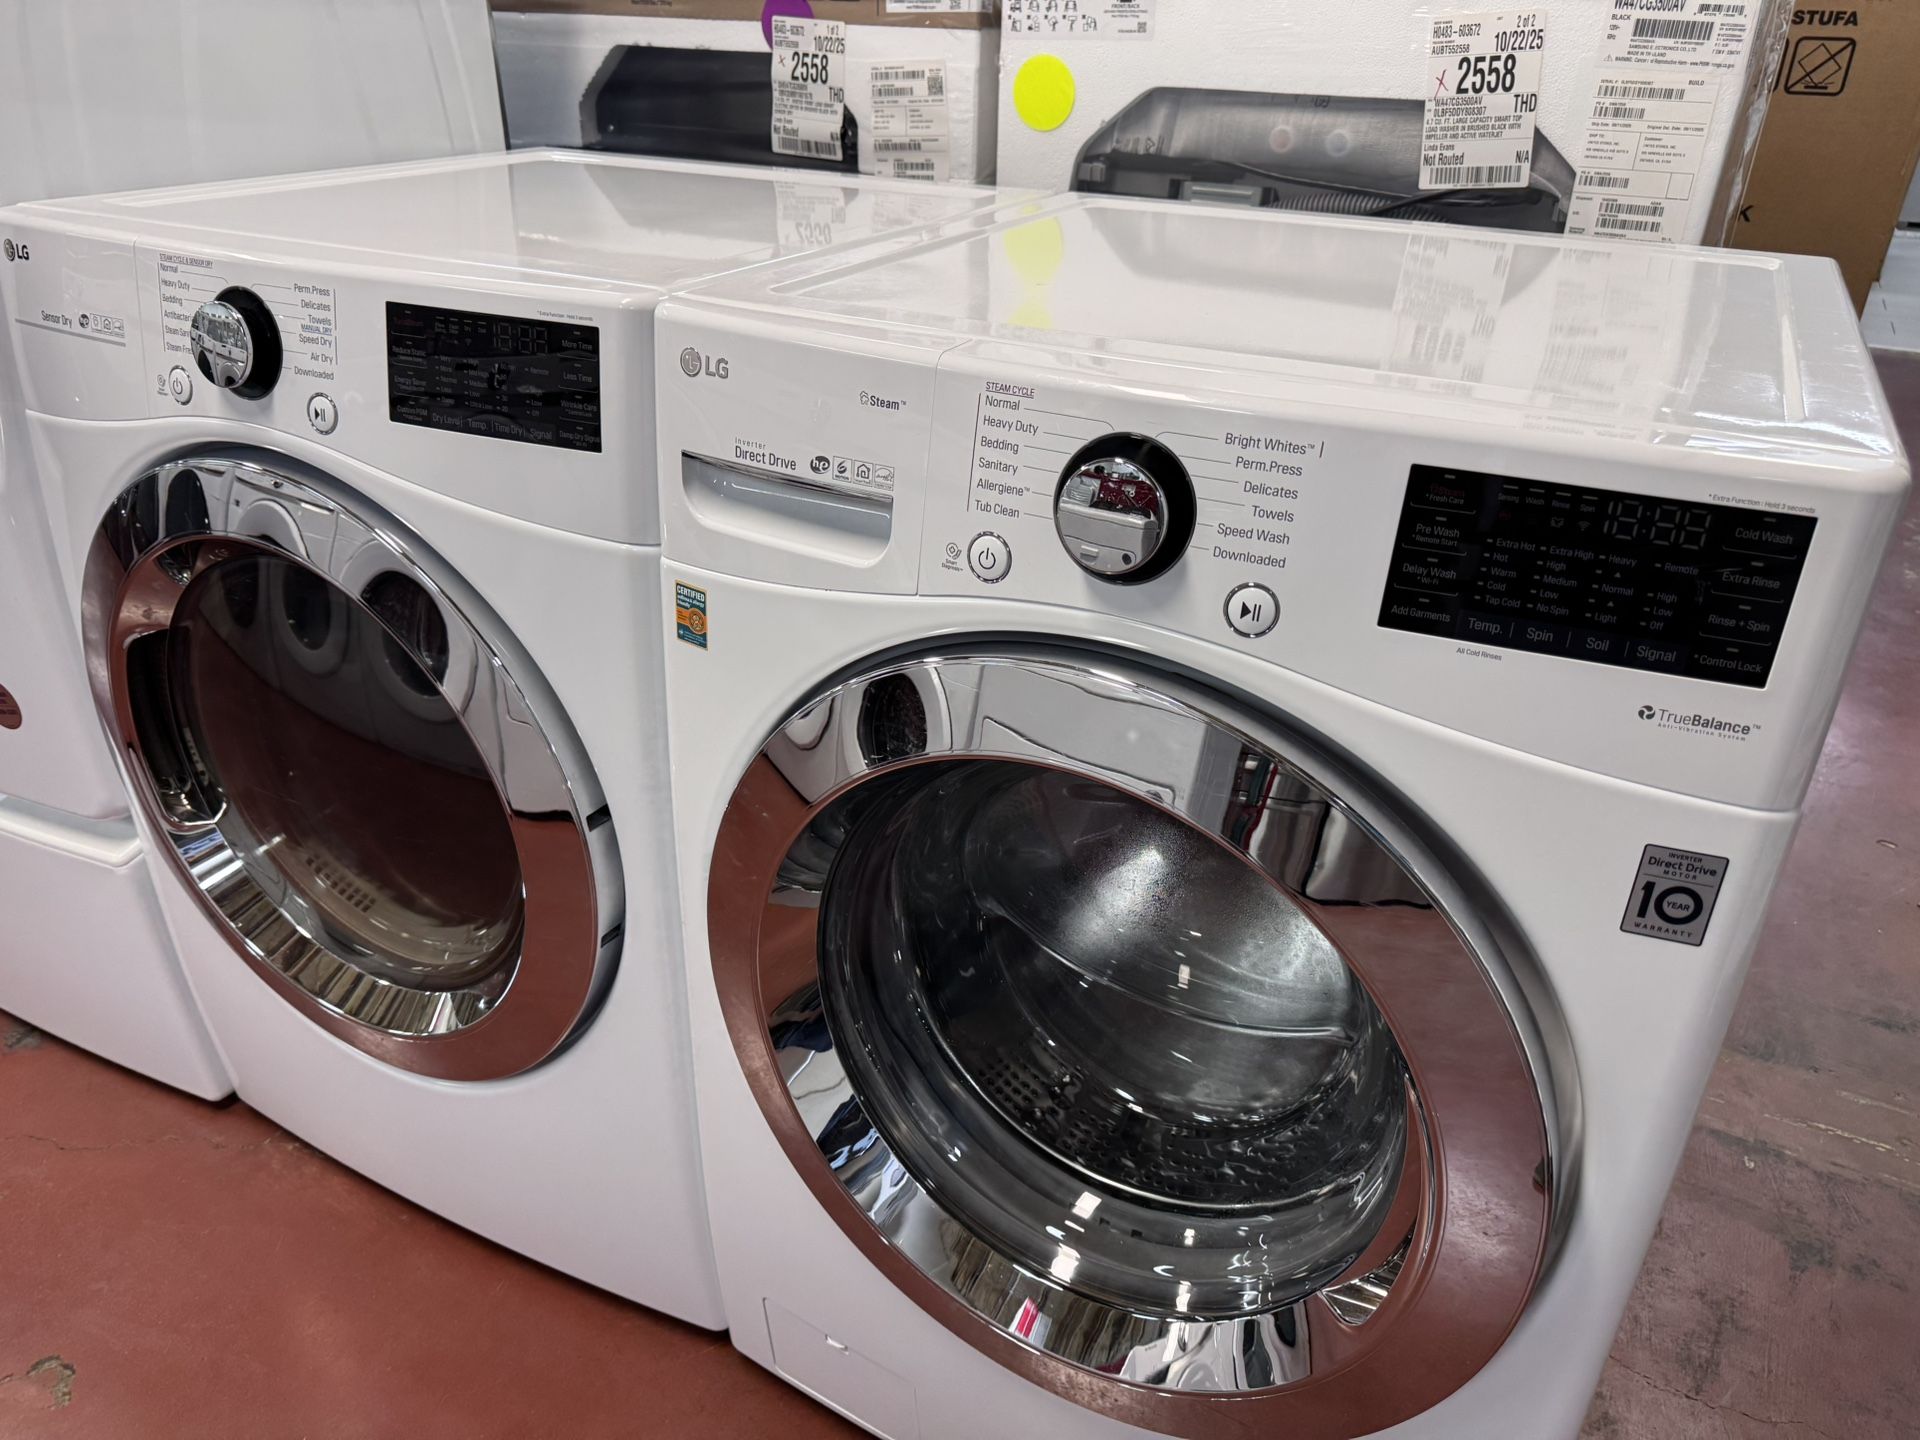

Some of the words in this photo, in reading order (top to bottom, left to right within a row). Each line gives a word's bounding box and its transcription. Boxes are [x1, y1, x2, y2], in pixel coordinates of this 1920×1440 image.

[1791, 10, 1858, 26] STUFA
[814, 36, 845, 54] 10/22/25
[1495, 28, 1544, 52] 10/22/25
[792, 52, 828, 84] 2558
[1456, 54, 1516, 94] 2558
[829, 87, 844, 104] THD
[1514, 94, 1537, 112] THD
[1423, 153, 1436, 166] Not
[1438, 152, 1464, 166] Routed
[1516, 150, 1529, 163] N/A
[16, 244, 29, 260] LG
[160, 263, 178, 273] Normal
[161, 278, 177, 289] Heavy
[178, 280, 190, 292] Duty
[294, 284, 330, 296] Perm.Press
[162, 294, 183, 306] Bedding
[301, 299, 331, 311] Delicates
[41, 310, 60, 324] Sensor
[61, 314, 72, 328] Dry
[308, 314, 332, 326] Towels
[166, 325, 180, 335] Steam
[299, 334, 319, 344] Speed
[320, 338, 332, 348] Dry
[562, 340, 577, 348] More
[578, 342, 593, 350] Time
[311, 352, 320, 361] Air
[322, 354, 333, 365] Dry
[294, 366, 334, 380] Downloaded
[705, 355, 729, 379] LG
[563, 372, 578, 380] Less
[578, 374, 593, 382] Time
[986, 381, 1011, 393] STEAM
[1012, 386, 1035, 397] CYCLE
[985, 395, 1020, 411] Normal
[432, 413, 444, 423] Dry
[444, 414, 460, 425] Level
[467, 418, 486, 430] Temp.
[983, 415, 1014, 431] Heavy
[1015, 420, 1039, 436] Duty
[495, 421, 511, 432] Time
[512, 424, 522, 436] Dry
[530, 428, 552, 440] Signal
[735, 437, 766, 450] Inverter
[980, 436, 1019, 454] Bedding
[1225, 432, 1261, 449] Bright
[735, 446, 766, 464] Direct
[768, 453, 797, 470] Drive
[979, 457, 1018, 476] Sanitary
[1235, 456, 1303, 476] Perm.Press
[1244, 480, 1298, 500] Delicates
[975, 500, 992, 513] Tub
[993, 502, 1020, 518] Clean
[1712, 494, 1730, 502] Extra
[1732, 496, 1760, 505] Function
[1787, 504, 1816, 514] seconds
[1252, 505, 1294, 522] Towels
[1217, 523, 1254, 540] Speed
[1257, 529, 1290, 545] Wash
[1416, 523, 1432, 534] Pre
[1434, 525, 1460, 538] Wash
[1735, 528, 1759, 540] Cold
[1761, 531, 1794, 544] Wash
[1496, 538, 1519, 550] Extra
[1520, 541, 1536, 552] Hot
[1213, 546, 1286, 568] Downloaded
[1493, 553, 1509, 562] Hot
[1550, 546, 1573, 557] Extra
[1574, 549, 1594, 561] High
[1546, 560, 1567, 571] High
[1609, 555, 1637, 568] Heavy
[1402, 562, 1429, 576] Delay
[1430, 566, 1456, 580] Wash
[1490, 567, 1517, 578] Warm
[1664, 562, 1699, 576] Remote
[1486, 580, 1506, 591] Cold
[1542, 574, 1577, 587] Medium
[1722, 572, 1750, 585] Extra
[1752, 575, 1781, 589] Rinse
[677, 585, 705, 602] CERTIFIED
[1539, 589, 1559, 600] Low
[1602, 584, 1634, 596] Normal
[1485, 595, 1500, 607] Tap
[1501, 596, 1521, 608] Cold
[1657, 592, 1678, 603] High
[1391, 604, 1409, 615] Add
[1410, 608, 1451, 623] Garments
[1536, 604, 1549, 613] No
[1550, 605, 1569, 616] Spin
[1653, 607, 1673, 618] Low
[1594, 612, 1617, 624] Light
[1708, 614, 1736, 628] Rinse
[1747, 621, 1770, 632] Spin
[1468, 617, 1503, 634] Temp.
[1650, 621, 1664, 631] Off
[1526, 627, 1554, 642] Spin
[1586, 637, 1609, 651] Soil
[1466, 648, 1480, 656] Cold
[1481, 651, 1502, 660] Rinses
[1636, 646, 1677, 662] Signal
[1700, 654, 1737, 670] Control
[1738, 660, 1762, 673] Lock
[1658, 723, 1714, 736] Anti-Vibration
[1668, 852, 1702, 863] INVERTER
[1648, 856, 1683, 870] Direct
[1686, 864, 1717, 877] Drive
[1663, 870, 1697, 880] MOTOR
[1637, 880, 1703, 925] 10
[1666, 900, 1690, 912] YEAR
[1634, 922, 1692, 938] WARRANTY
